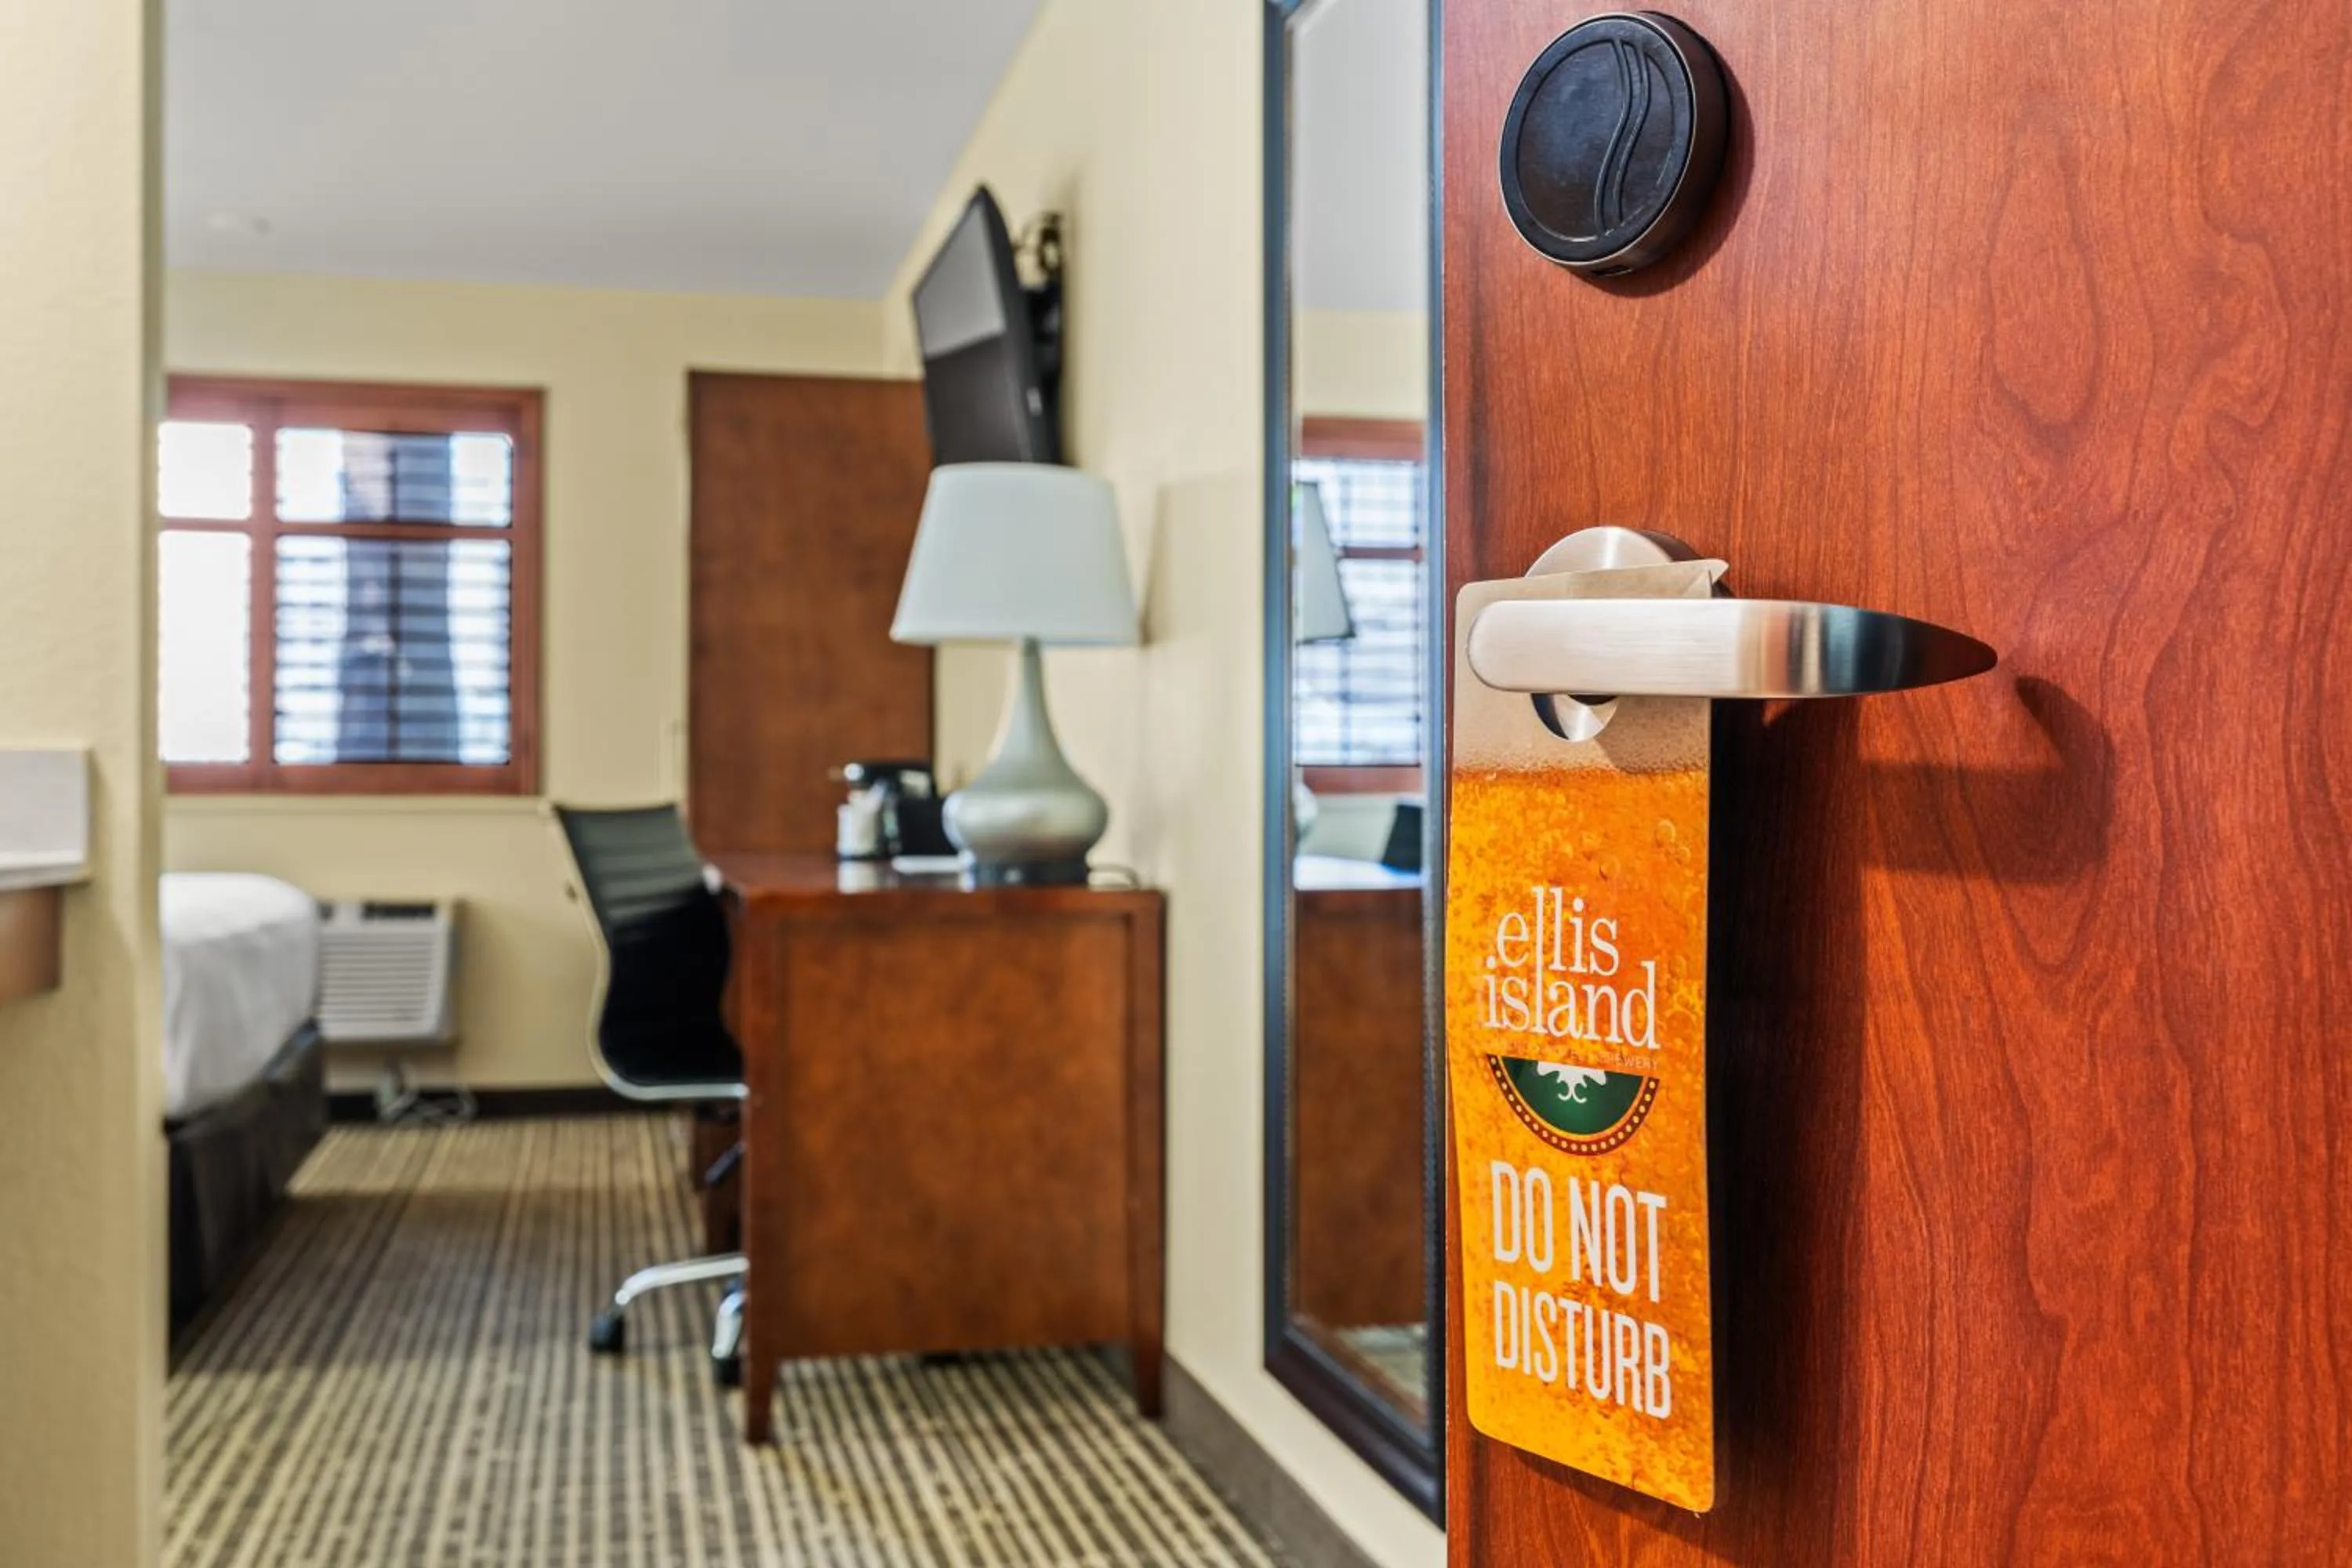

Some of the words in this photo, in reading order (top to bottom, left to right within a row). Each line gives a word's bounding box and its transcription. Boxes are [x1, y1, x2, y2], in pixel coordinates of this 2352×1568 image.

[1496, 886, 1620, 977] ellis
[1483, 955, 1661, 1051] island
[1490, 1160, 1554, 1273] DO
[1570, 1176, 1667, 1303] NOT
[1494, 1279, 1672, 1420] DISTURB
